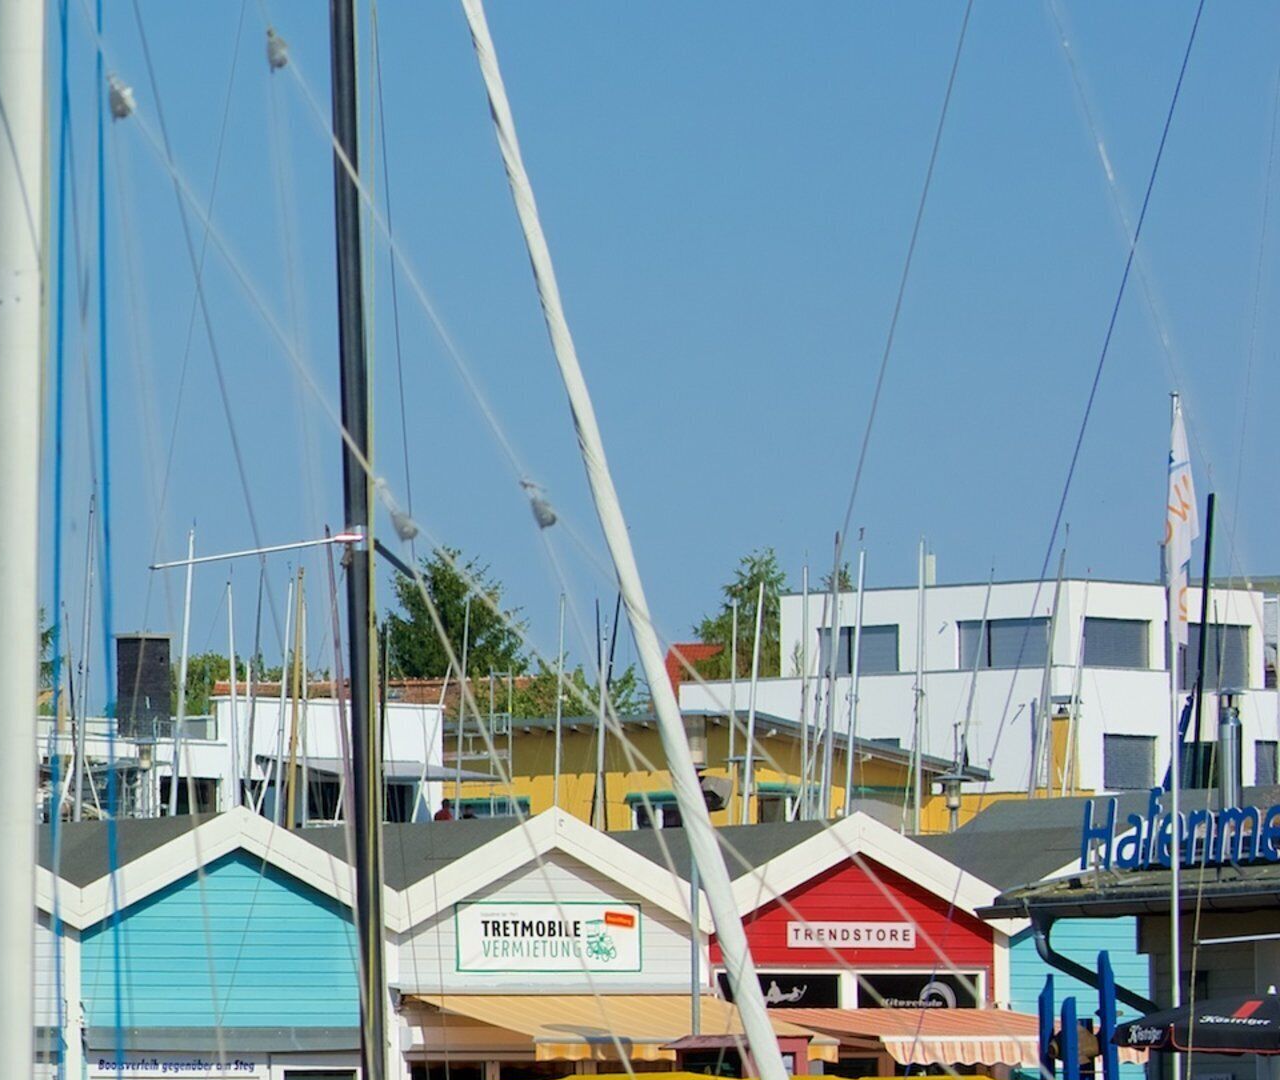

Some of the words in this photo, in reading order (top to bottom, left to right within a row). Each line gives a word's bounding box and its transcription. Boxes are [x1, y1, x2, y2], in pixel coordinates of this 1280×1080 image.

[481, 920, 581, 937] TRETMOBILE
[793, 928, 911, 942] TRENDSTORE
[482, 940, 582, 958] VERMIETUNG
[98, 1059, 159, 1071] Boosverleih
